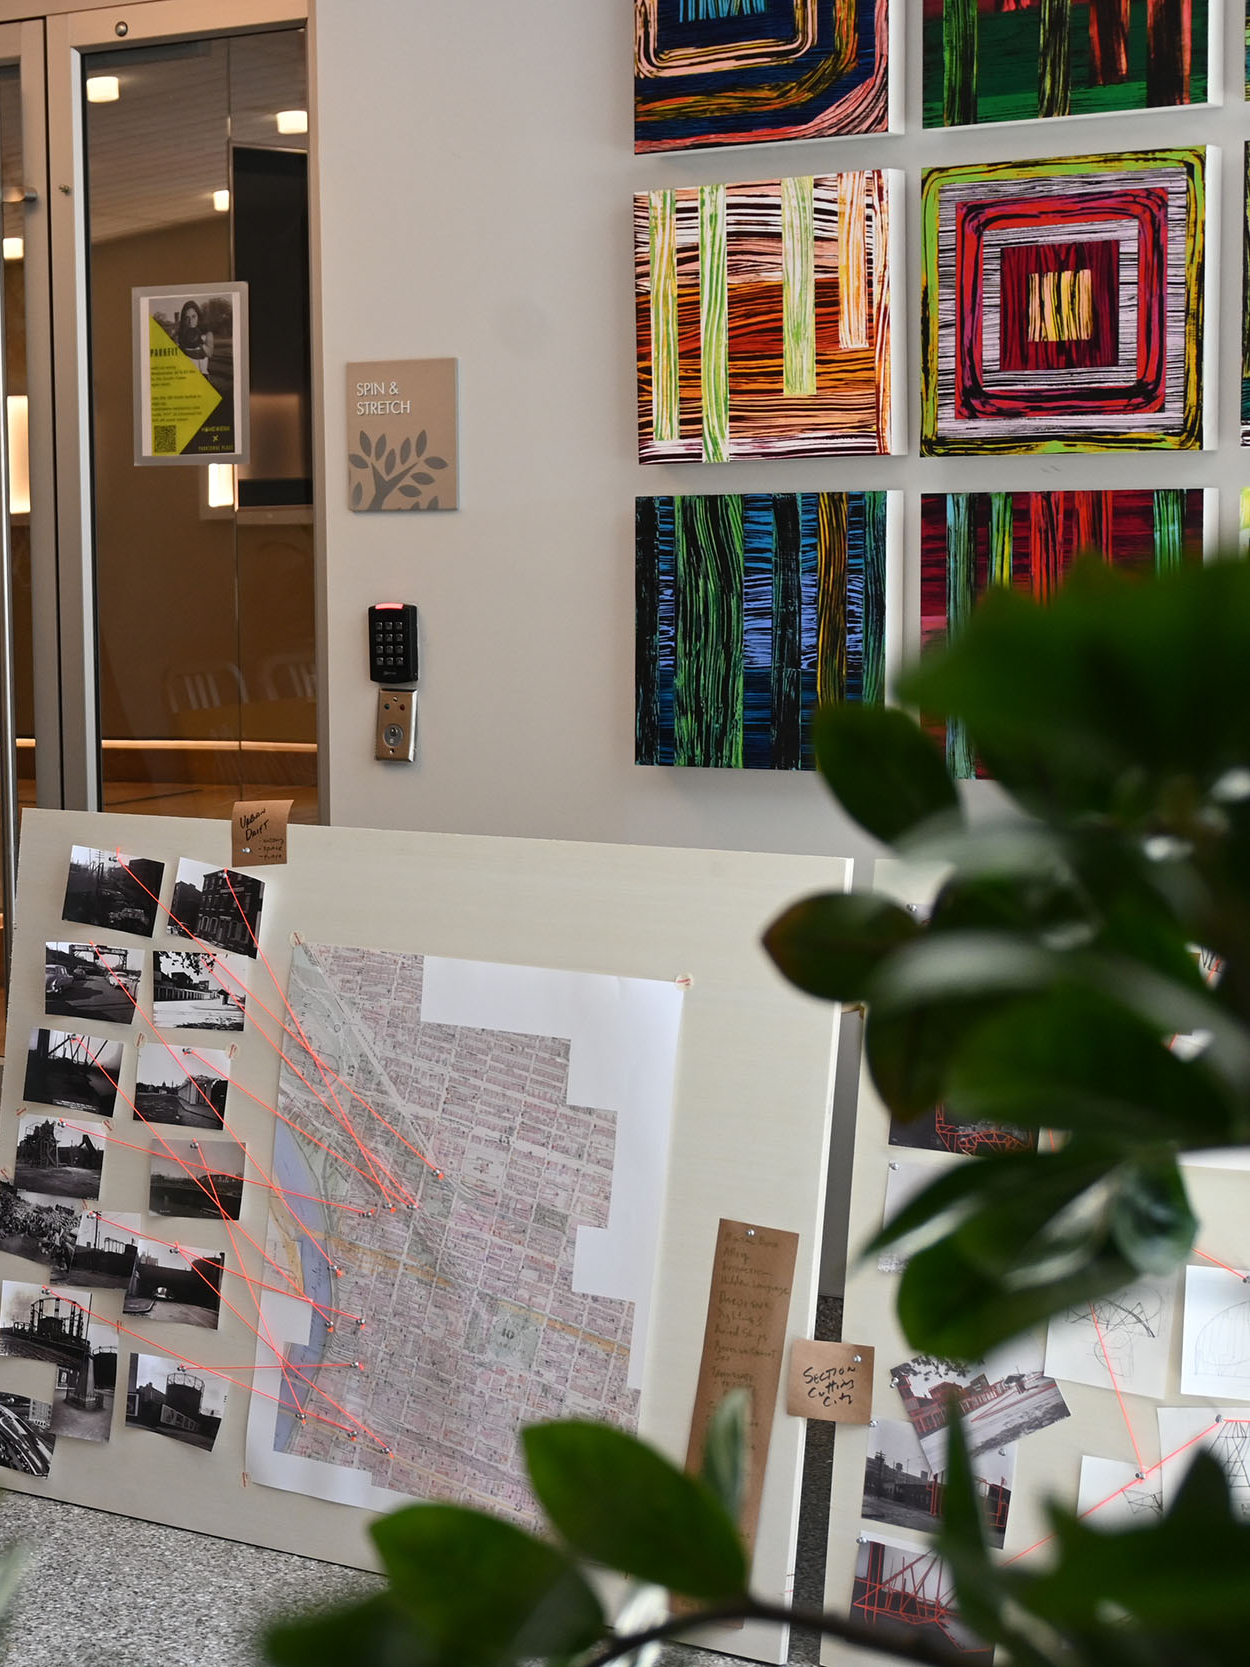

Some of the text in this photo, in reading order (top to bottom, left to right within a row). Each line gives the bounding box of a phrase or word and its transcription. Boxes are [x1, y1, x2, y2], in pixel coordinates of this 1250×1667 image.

[357, 381, 399, 396] SPIN &
[356, 400, 411, 416] STRETCH
